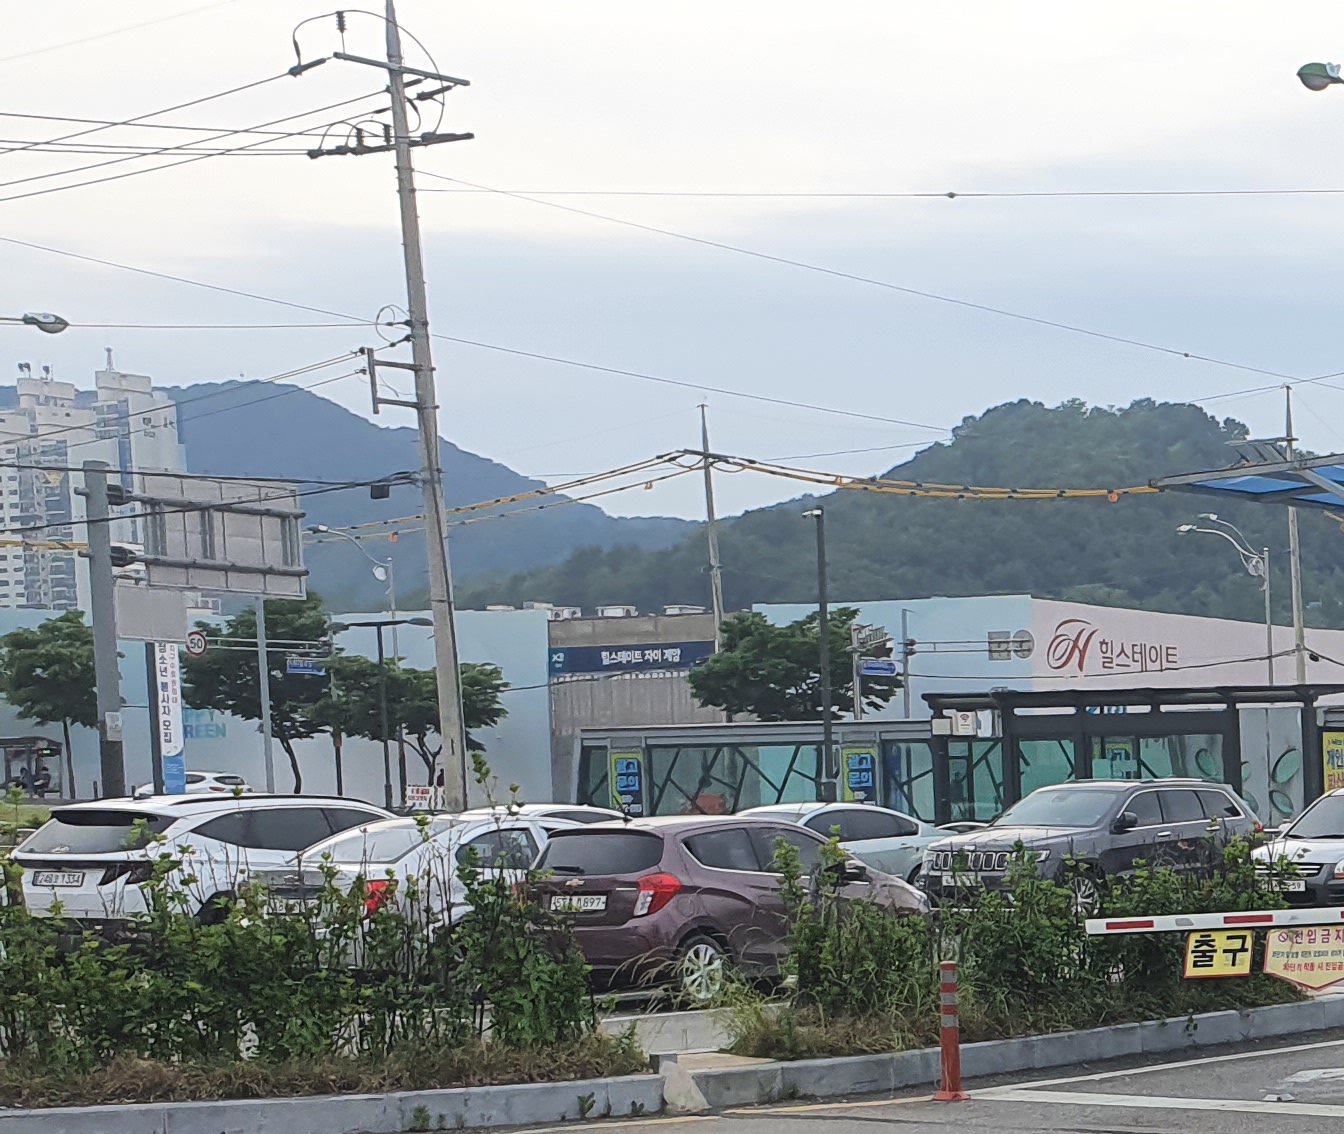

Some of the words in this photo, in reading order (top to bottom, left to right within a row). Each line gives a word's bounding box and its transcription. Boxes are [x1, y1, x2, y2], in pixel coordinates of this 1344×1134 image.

[190, 638, 203, 649] 50
[1099, 639, 1177, 672] 힐스테이트
[1191, 934, 1250, 969] 출구
